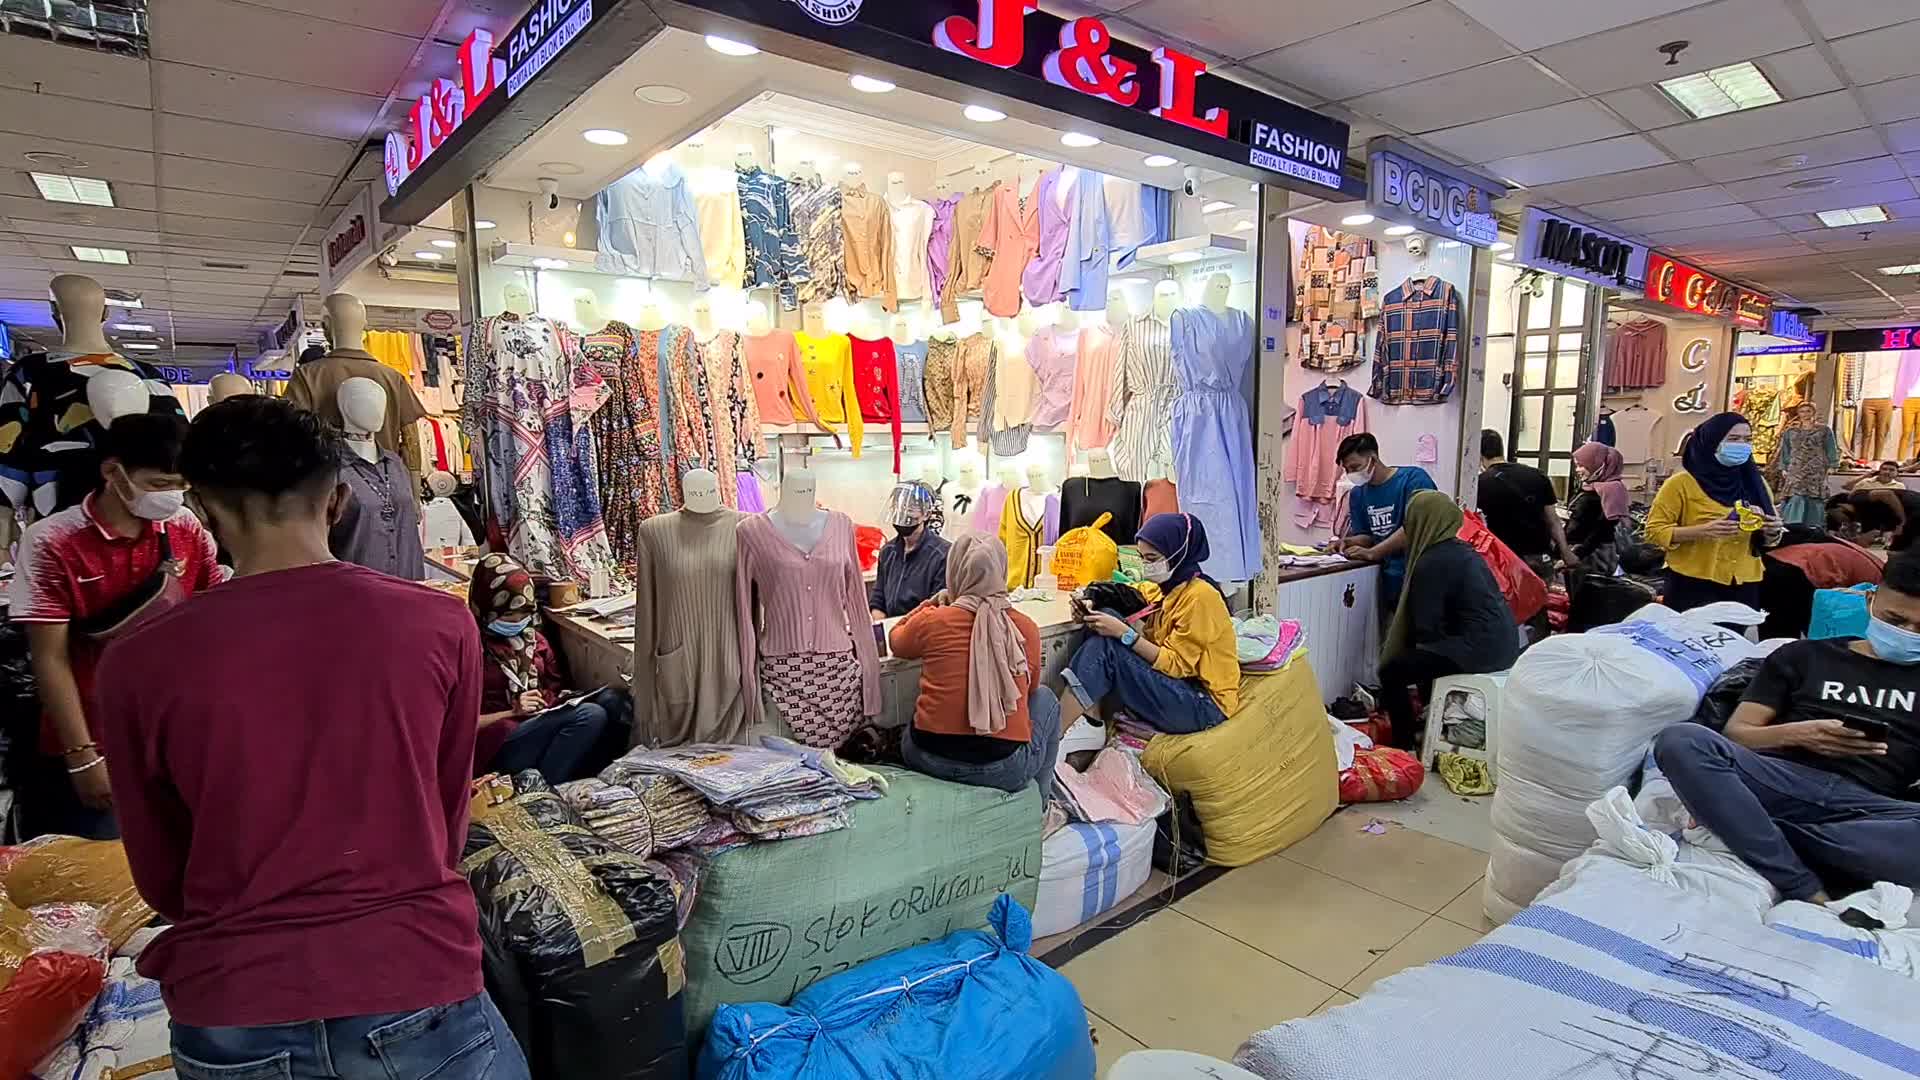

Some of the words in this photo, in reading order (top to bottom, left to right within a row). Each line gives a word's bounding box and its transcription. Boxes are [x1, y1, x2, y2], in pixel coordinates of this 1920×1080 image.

[510, 0, 578, 69] FASHI
[540, 37, 558, 64] BLOK
[932, 0, 1038, 68] J
[1042, 16, 1140, 107] &
[1150, 47, 1229, 138] L
[407, 96, 432, 171] J
[431, 77, 465, 148] &
[457, 28, 507, 121] L
[1252, 152, 1277, 169] PGMTA
[1292, 164, 1311, 179] BLOK
[1255, 123, 1341, 170] FASHION
[1383, 159, 1466, 226] BCDG
[1371, 512, 1392, 527] NYC
[1821, 681, 1916, 712] RAIN
